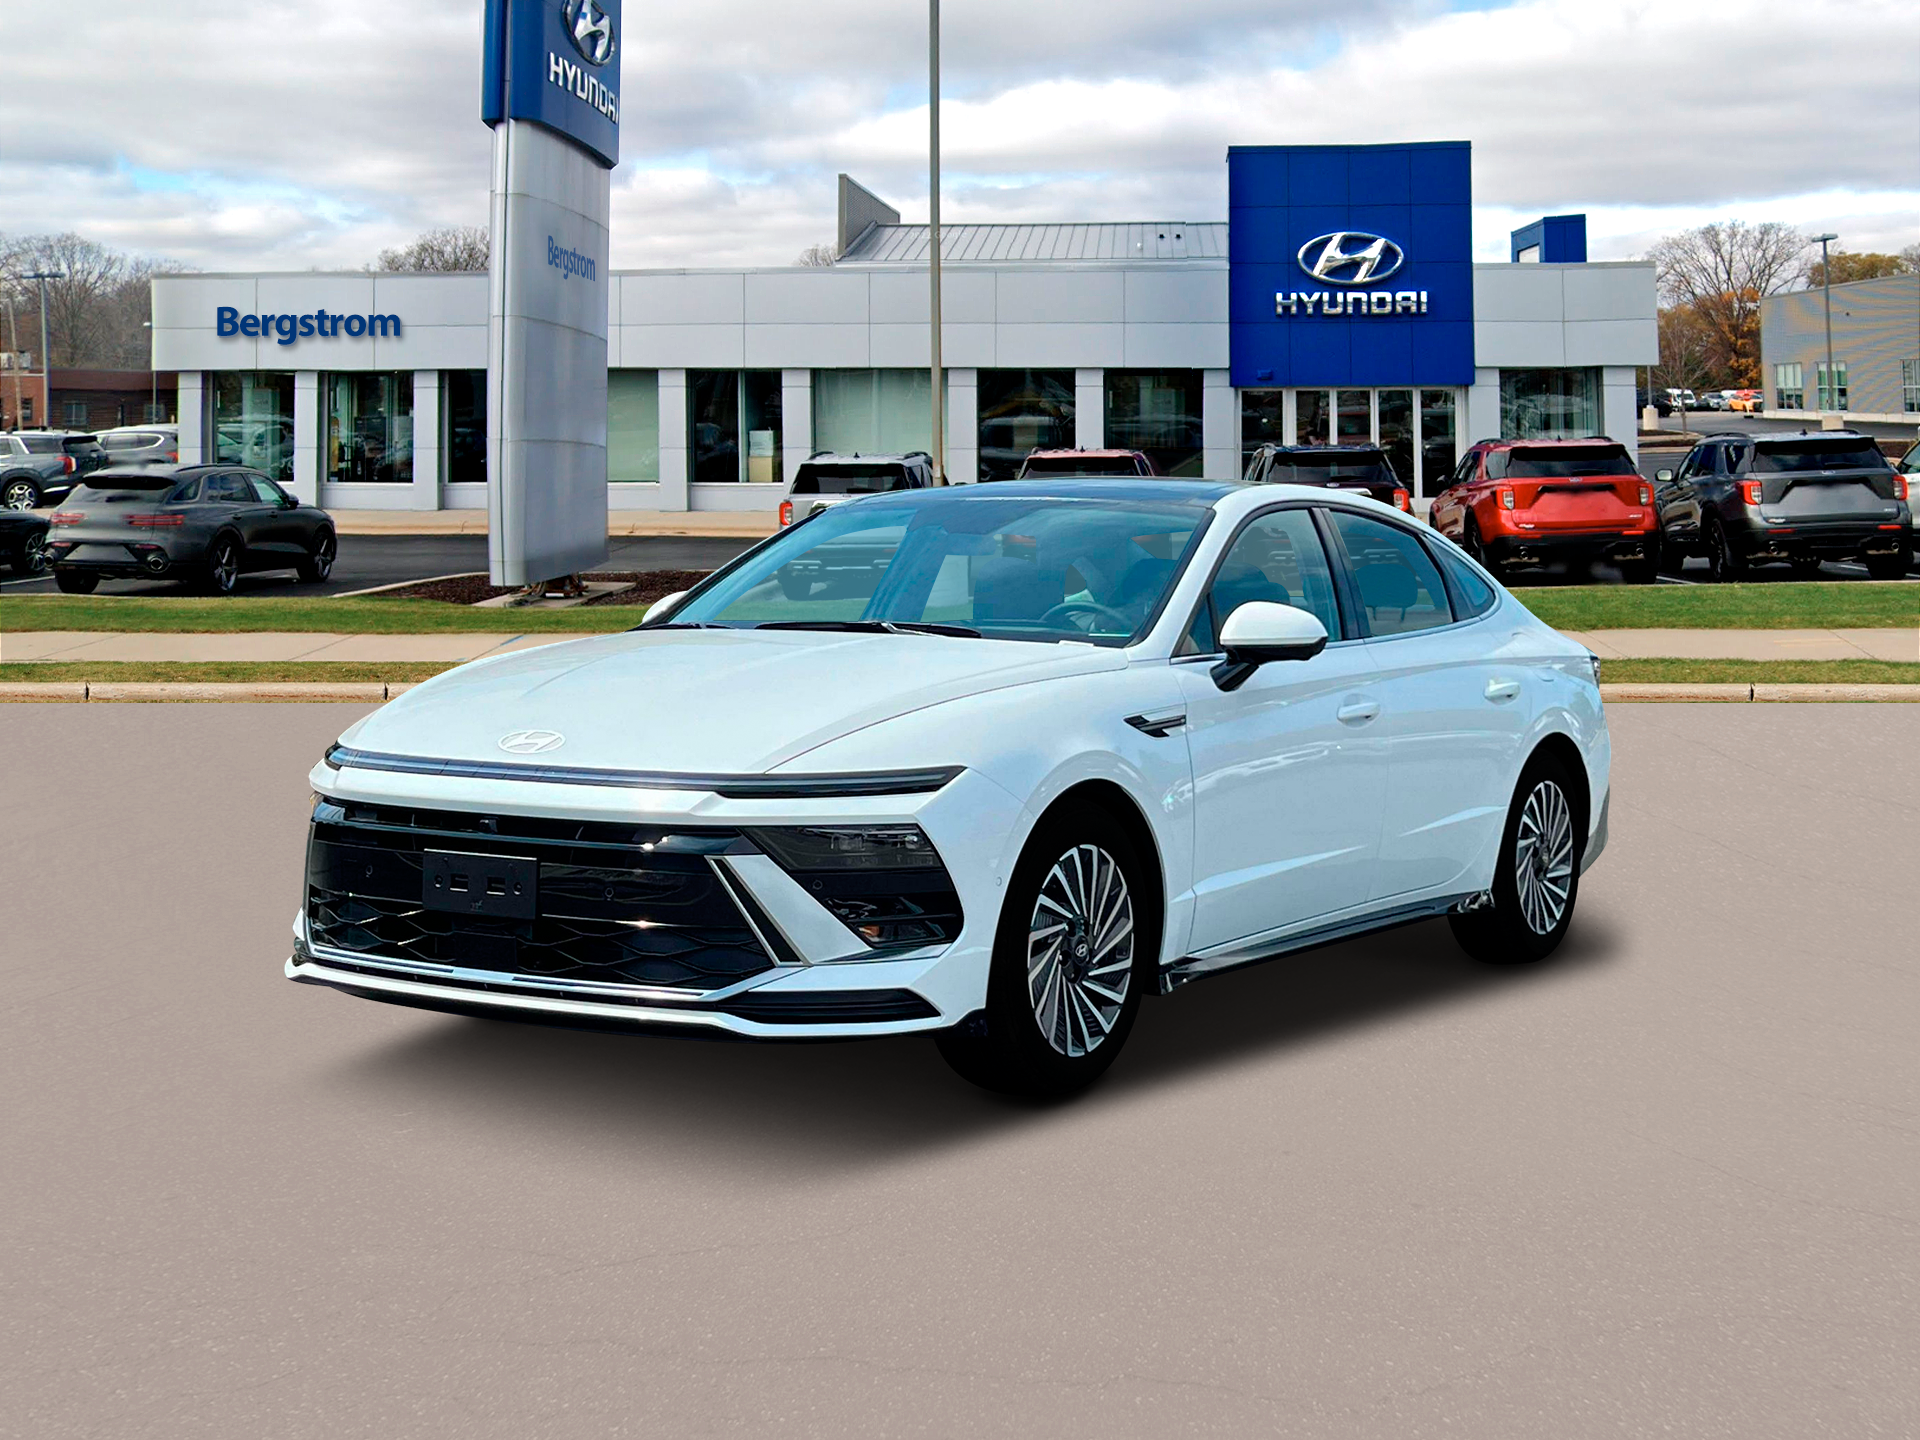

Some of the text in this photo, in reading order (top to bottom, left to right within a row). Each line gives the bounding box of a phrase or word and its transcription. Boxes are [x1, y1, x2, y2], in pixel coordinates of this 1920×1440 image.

[549, 52, 619, 124] HYUNDAI
[548, 235, 596, 282] Bergstrom
[1276, 291, 1428, 315] HYUNDAI
[217, 306, 401, 346] Bergstrom
